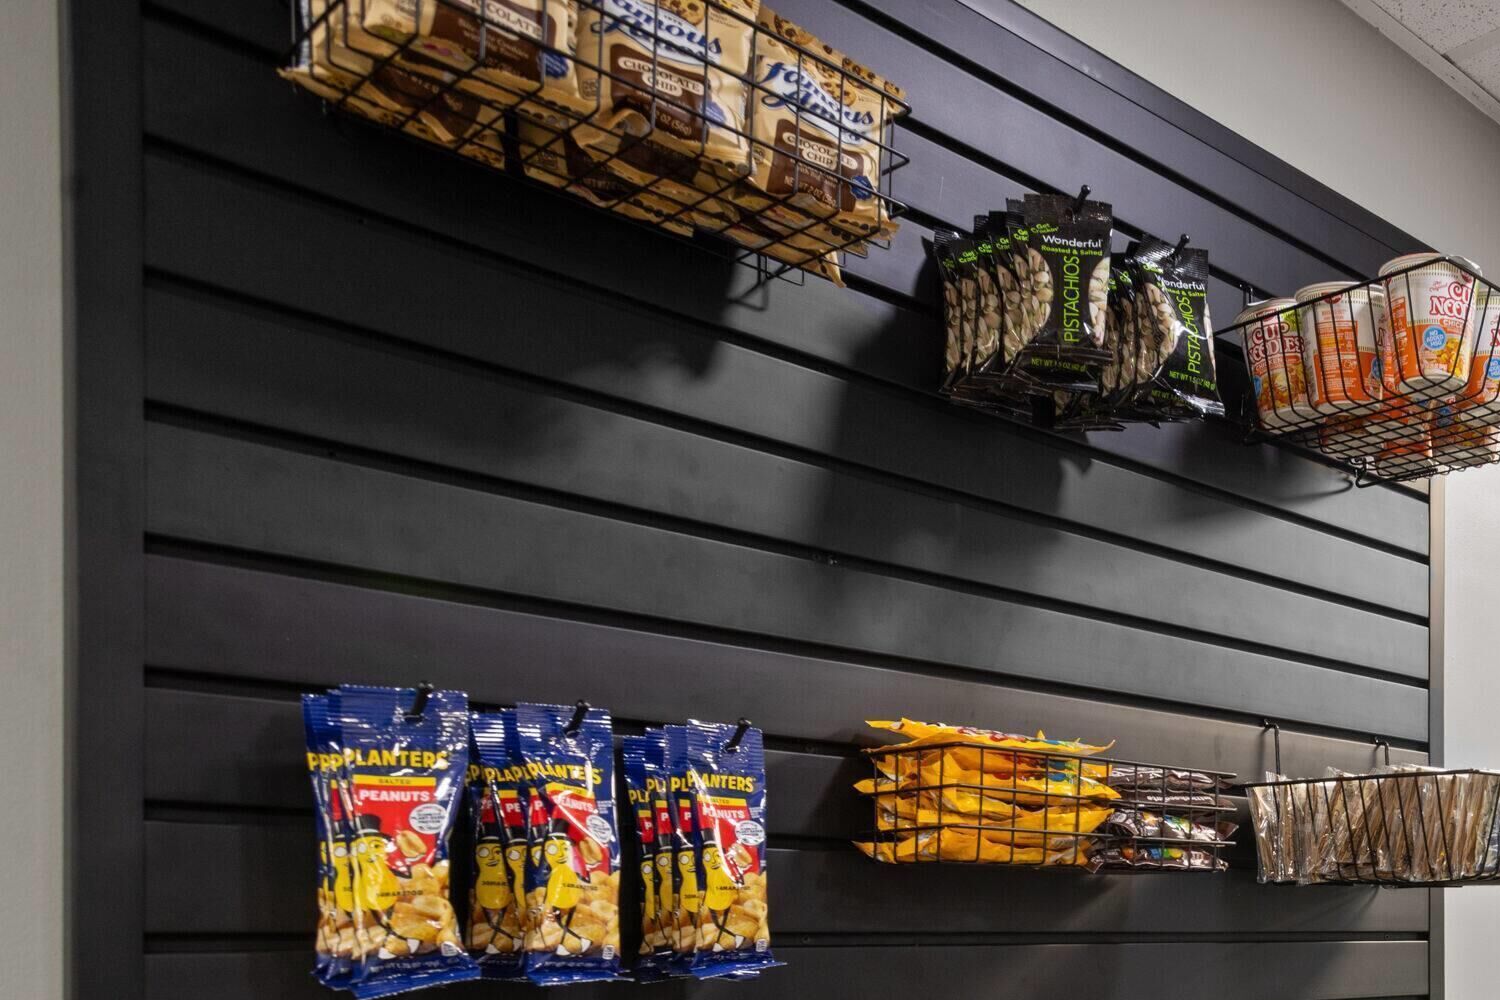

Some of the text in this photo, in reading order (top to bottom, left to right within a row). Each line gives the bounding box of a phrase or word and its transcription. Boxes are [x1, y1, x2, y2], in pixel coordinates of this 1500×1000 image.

[786, 136, 854, 167] COCOLTE
[1043, 235, 1102, 248] Wonderful
[1063, 255, 1080, 344] PISTACHIOS
[1448, 280, 1473, 301] CU
[343, 748, 449, 770] PLANTERS
[526, 762, 602, 784] PLANTES
[686, 770, 754, 792] PANTERS
[359, 788, 430, 802] PEANUTS
